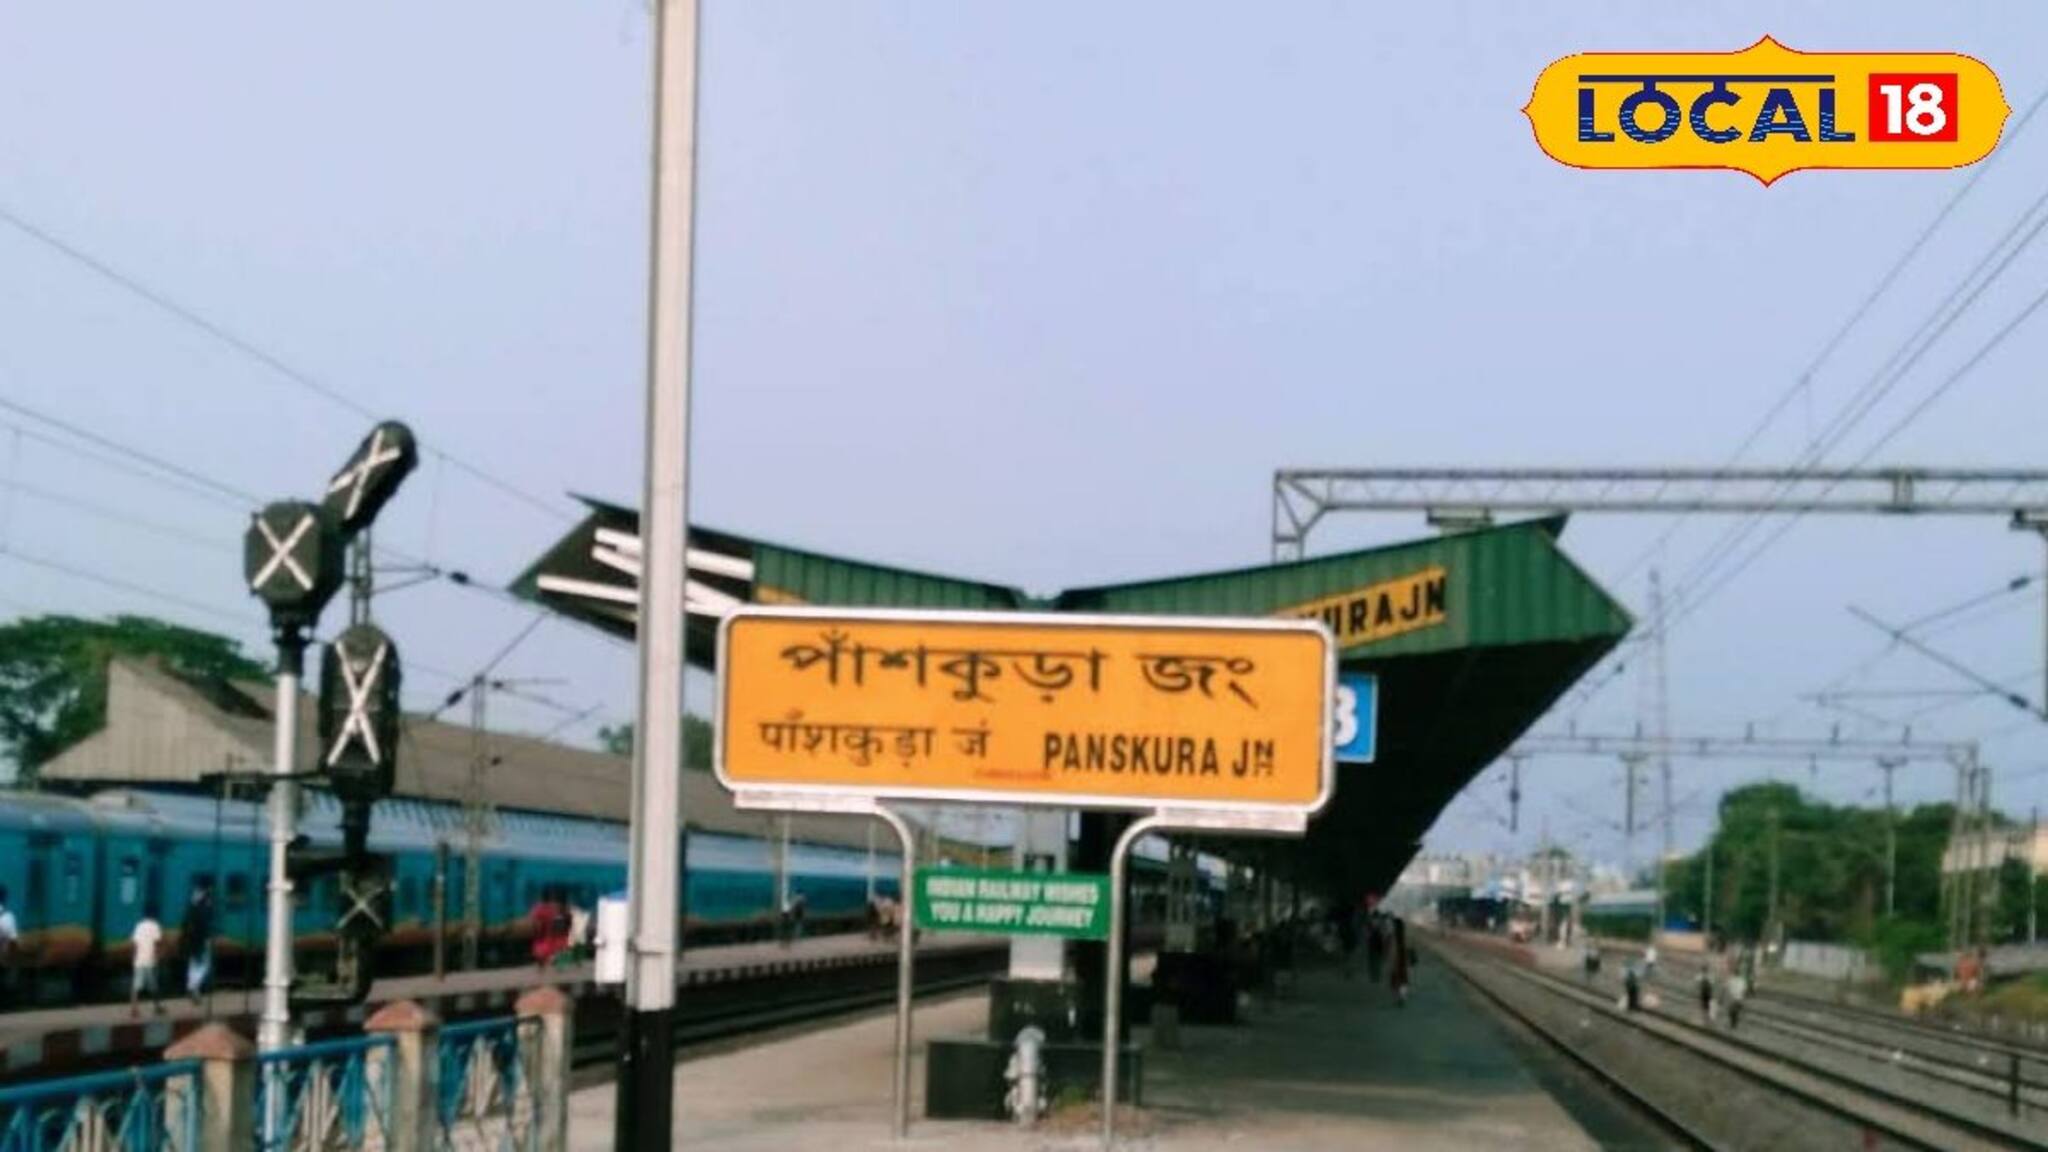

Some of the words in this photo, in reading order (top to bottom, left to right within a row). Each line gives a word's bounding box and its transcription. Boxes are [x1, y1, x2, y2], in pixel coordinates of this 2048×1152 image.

[780, 628, 1108, 703] পাঁশকুড়া
[1134, 654, 1258, 709] জং
[1044, 732, 1218, 776] PANSKURA
